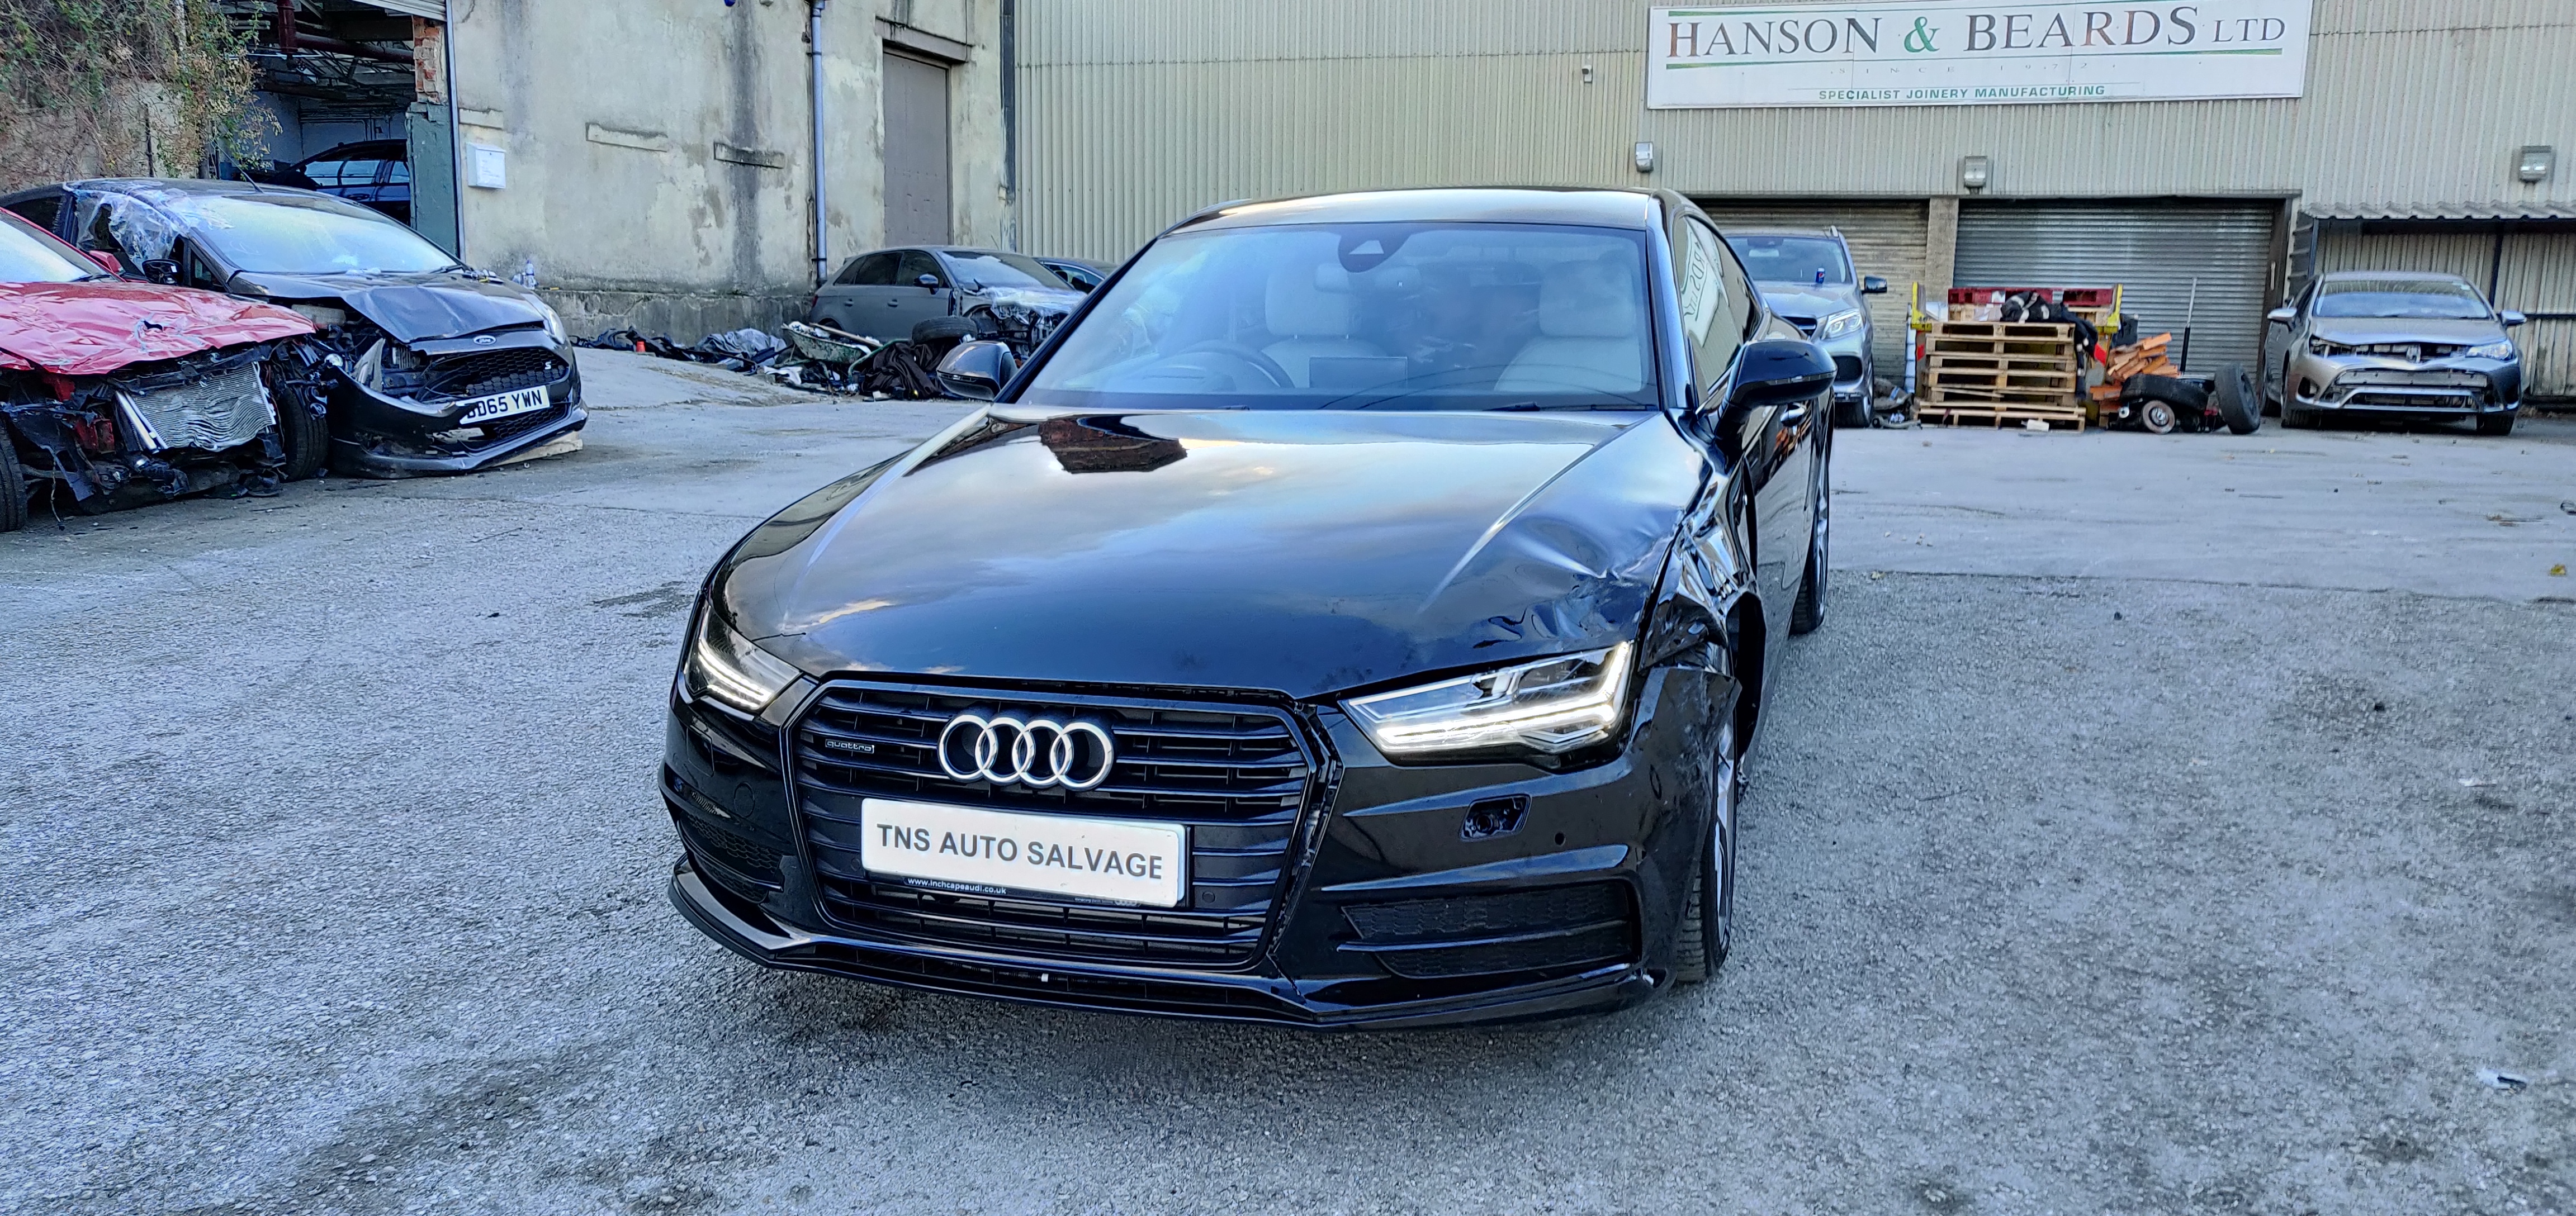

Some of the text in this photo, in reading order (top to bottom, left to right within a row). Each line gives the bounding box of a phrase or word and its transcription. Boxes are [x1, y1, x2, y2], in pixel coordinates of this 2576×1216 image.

[1666, 6, 2285, 58] HANSON & BEARDS LTD
[1819, 86, 2105, 100] SPECIALIST JOINERY MANUFACTURING
[512, 390, 542, 409] YWN
[827, 741, 872, 752] quattro
[877, 823, 1162, 879] TNS AUTO SALVAGE
[908, 878, 1006, 894] www.inchcapeaudi.co.uk
